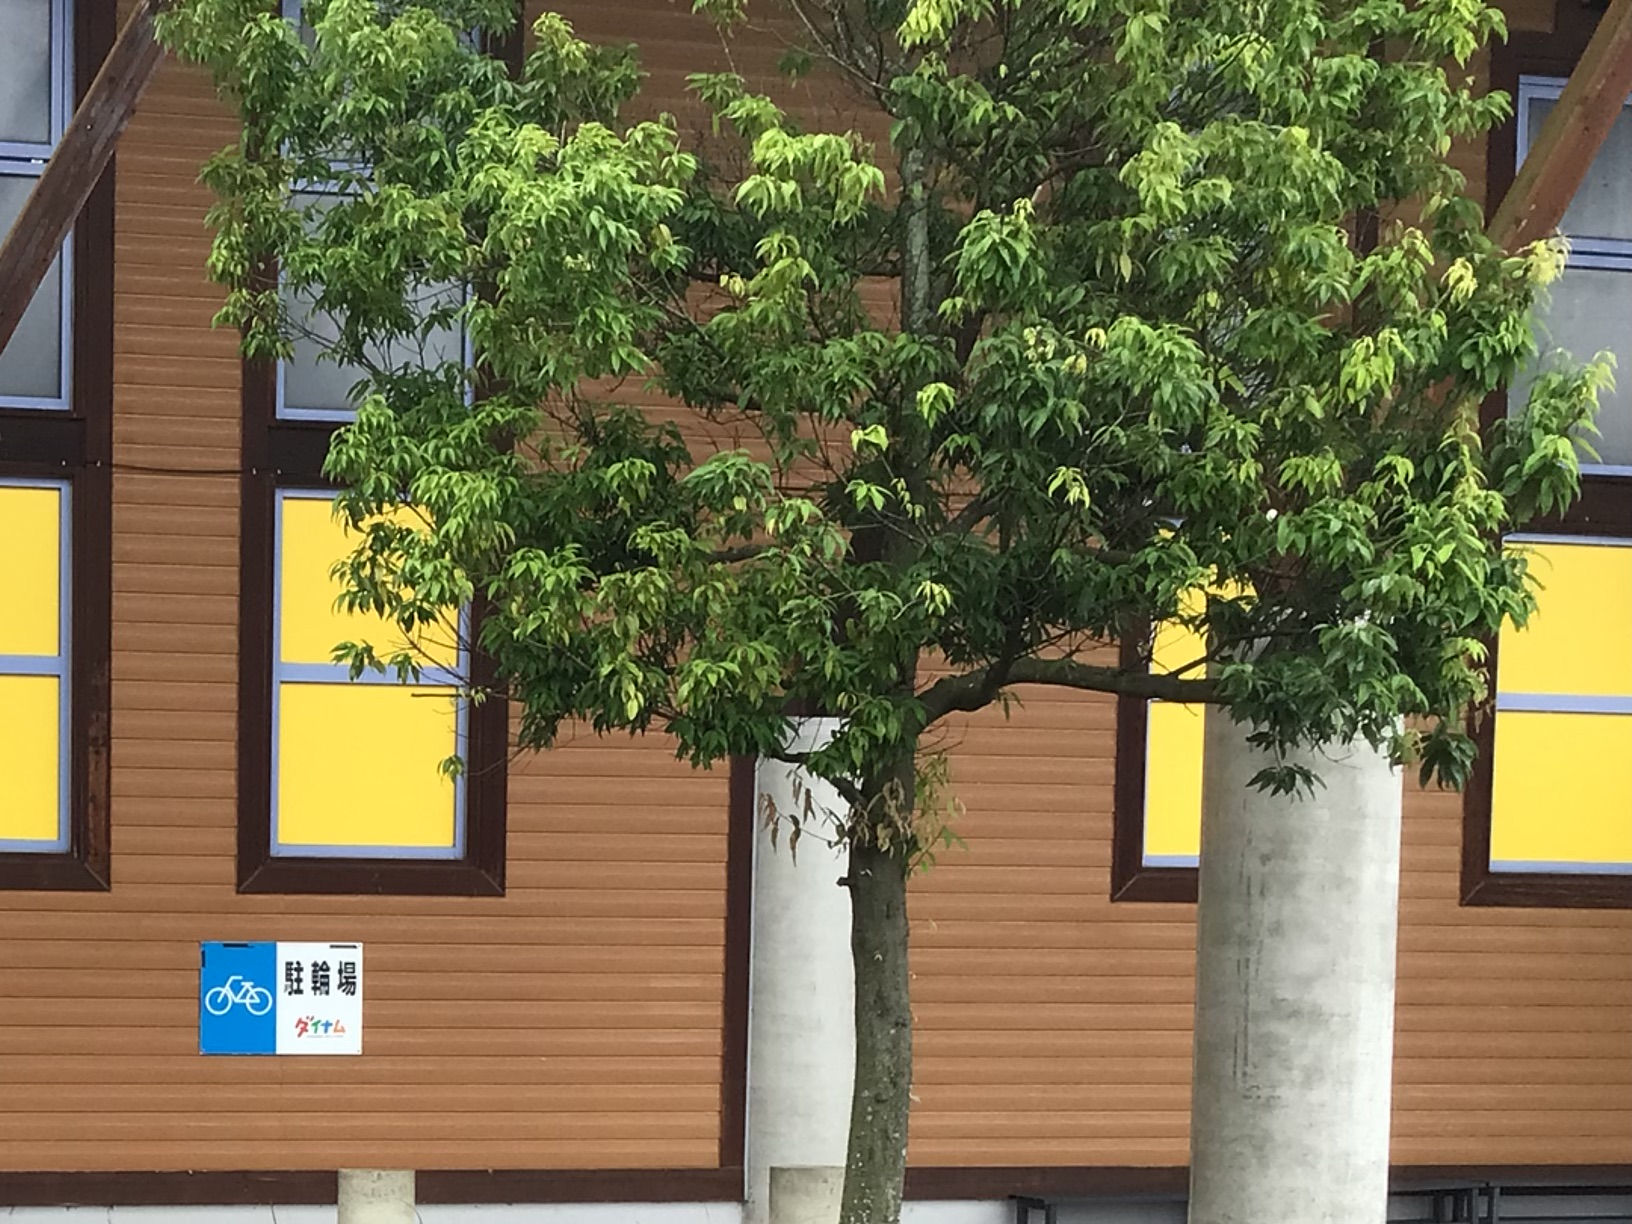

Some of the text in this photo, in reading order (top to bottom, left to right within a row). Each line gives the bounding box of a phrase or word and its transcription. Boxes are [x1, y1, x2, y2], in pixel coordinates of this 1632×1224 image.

[283, 960, 358, 996] 駐輪場
[294, 1016, 346, 1038] ダイナム
